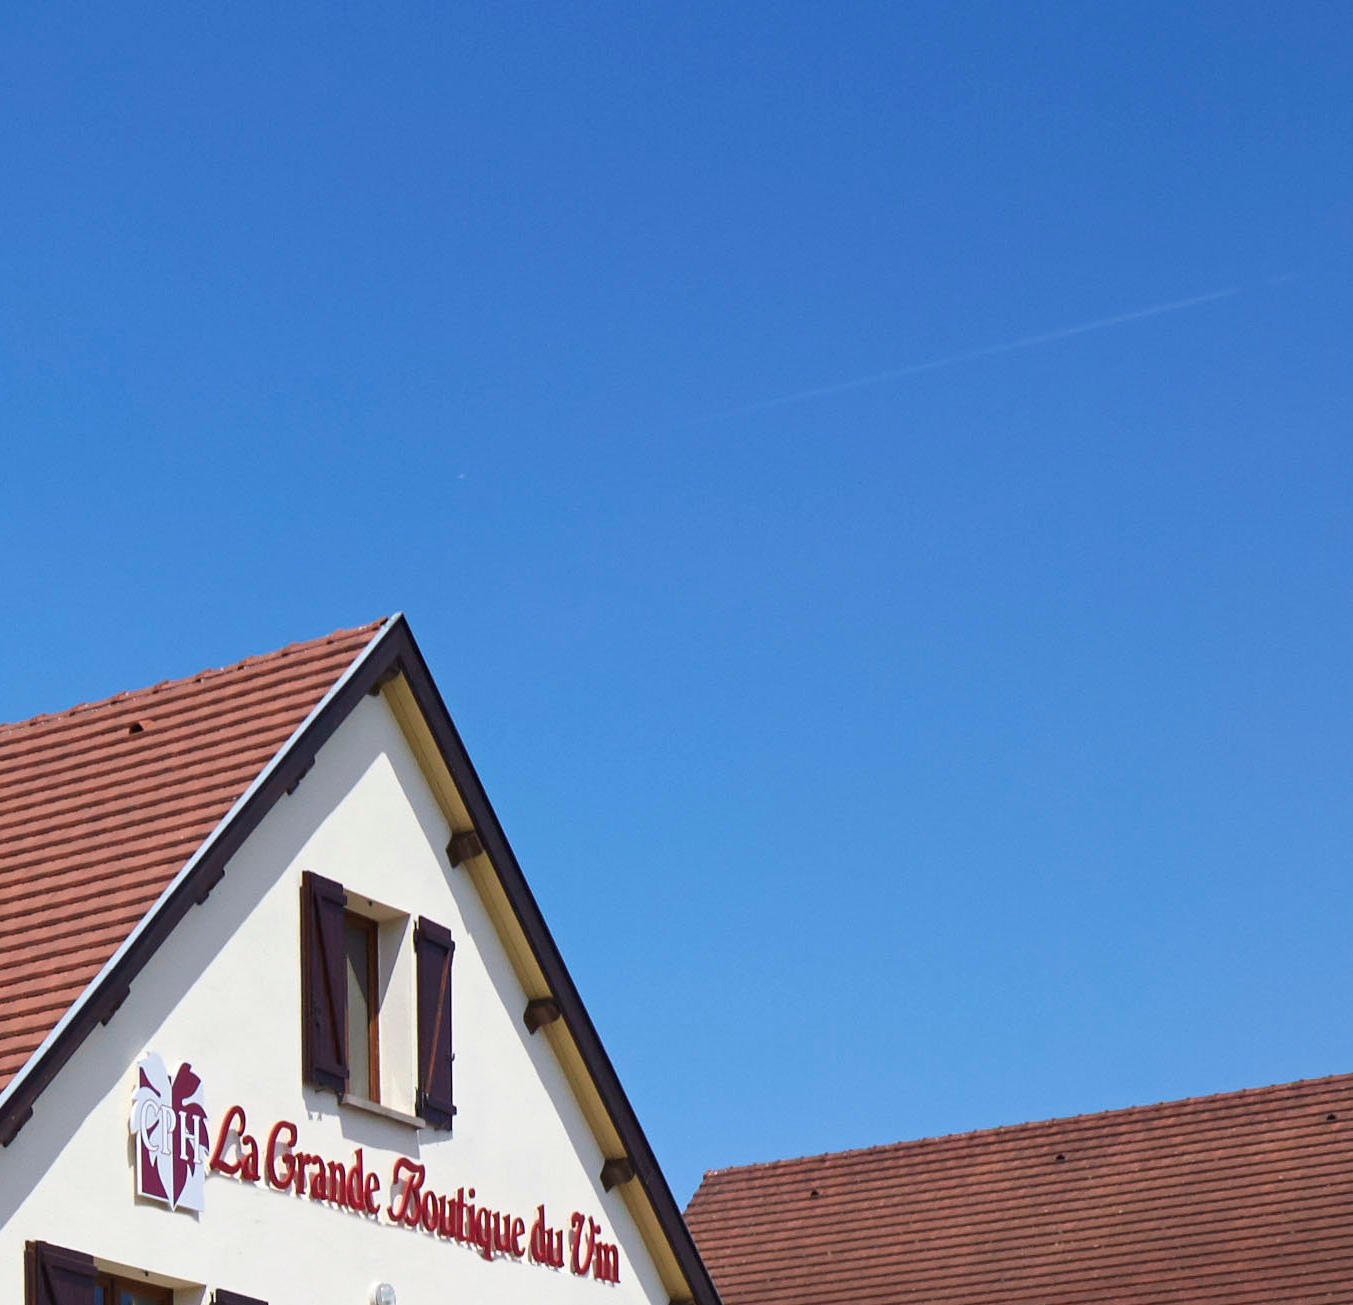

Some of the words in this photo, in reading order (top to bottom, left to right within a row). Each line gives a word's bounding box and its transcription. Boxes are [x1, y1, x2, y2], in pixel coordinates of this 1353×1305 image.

[138, 1099, 207, 1164] CPH
[210, 1105, 261, 1182] La
[265, 1120, 380, 1215] Grande
[387, 1158, 525, 1261] Boutique
[530, 1204, 565, 1269] du
[571, 1211, 620, 1284] Vin
